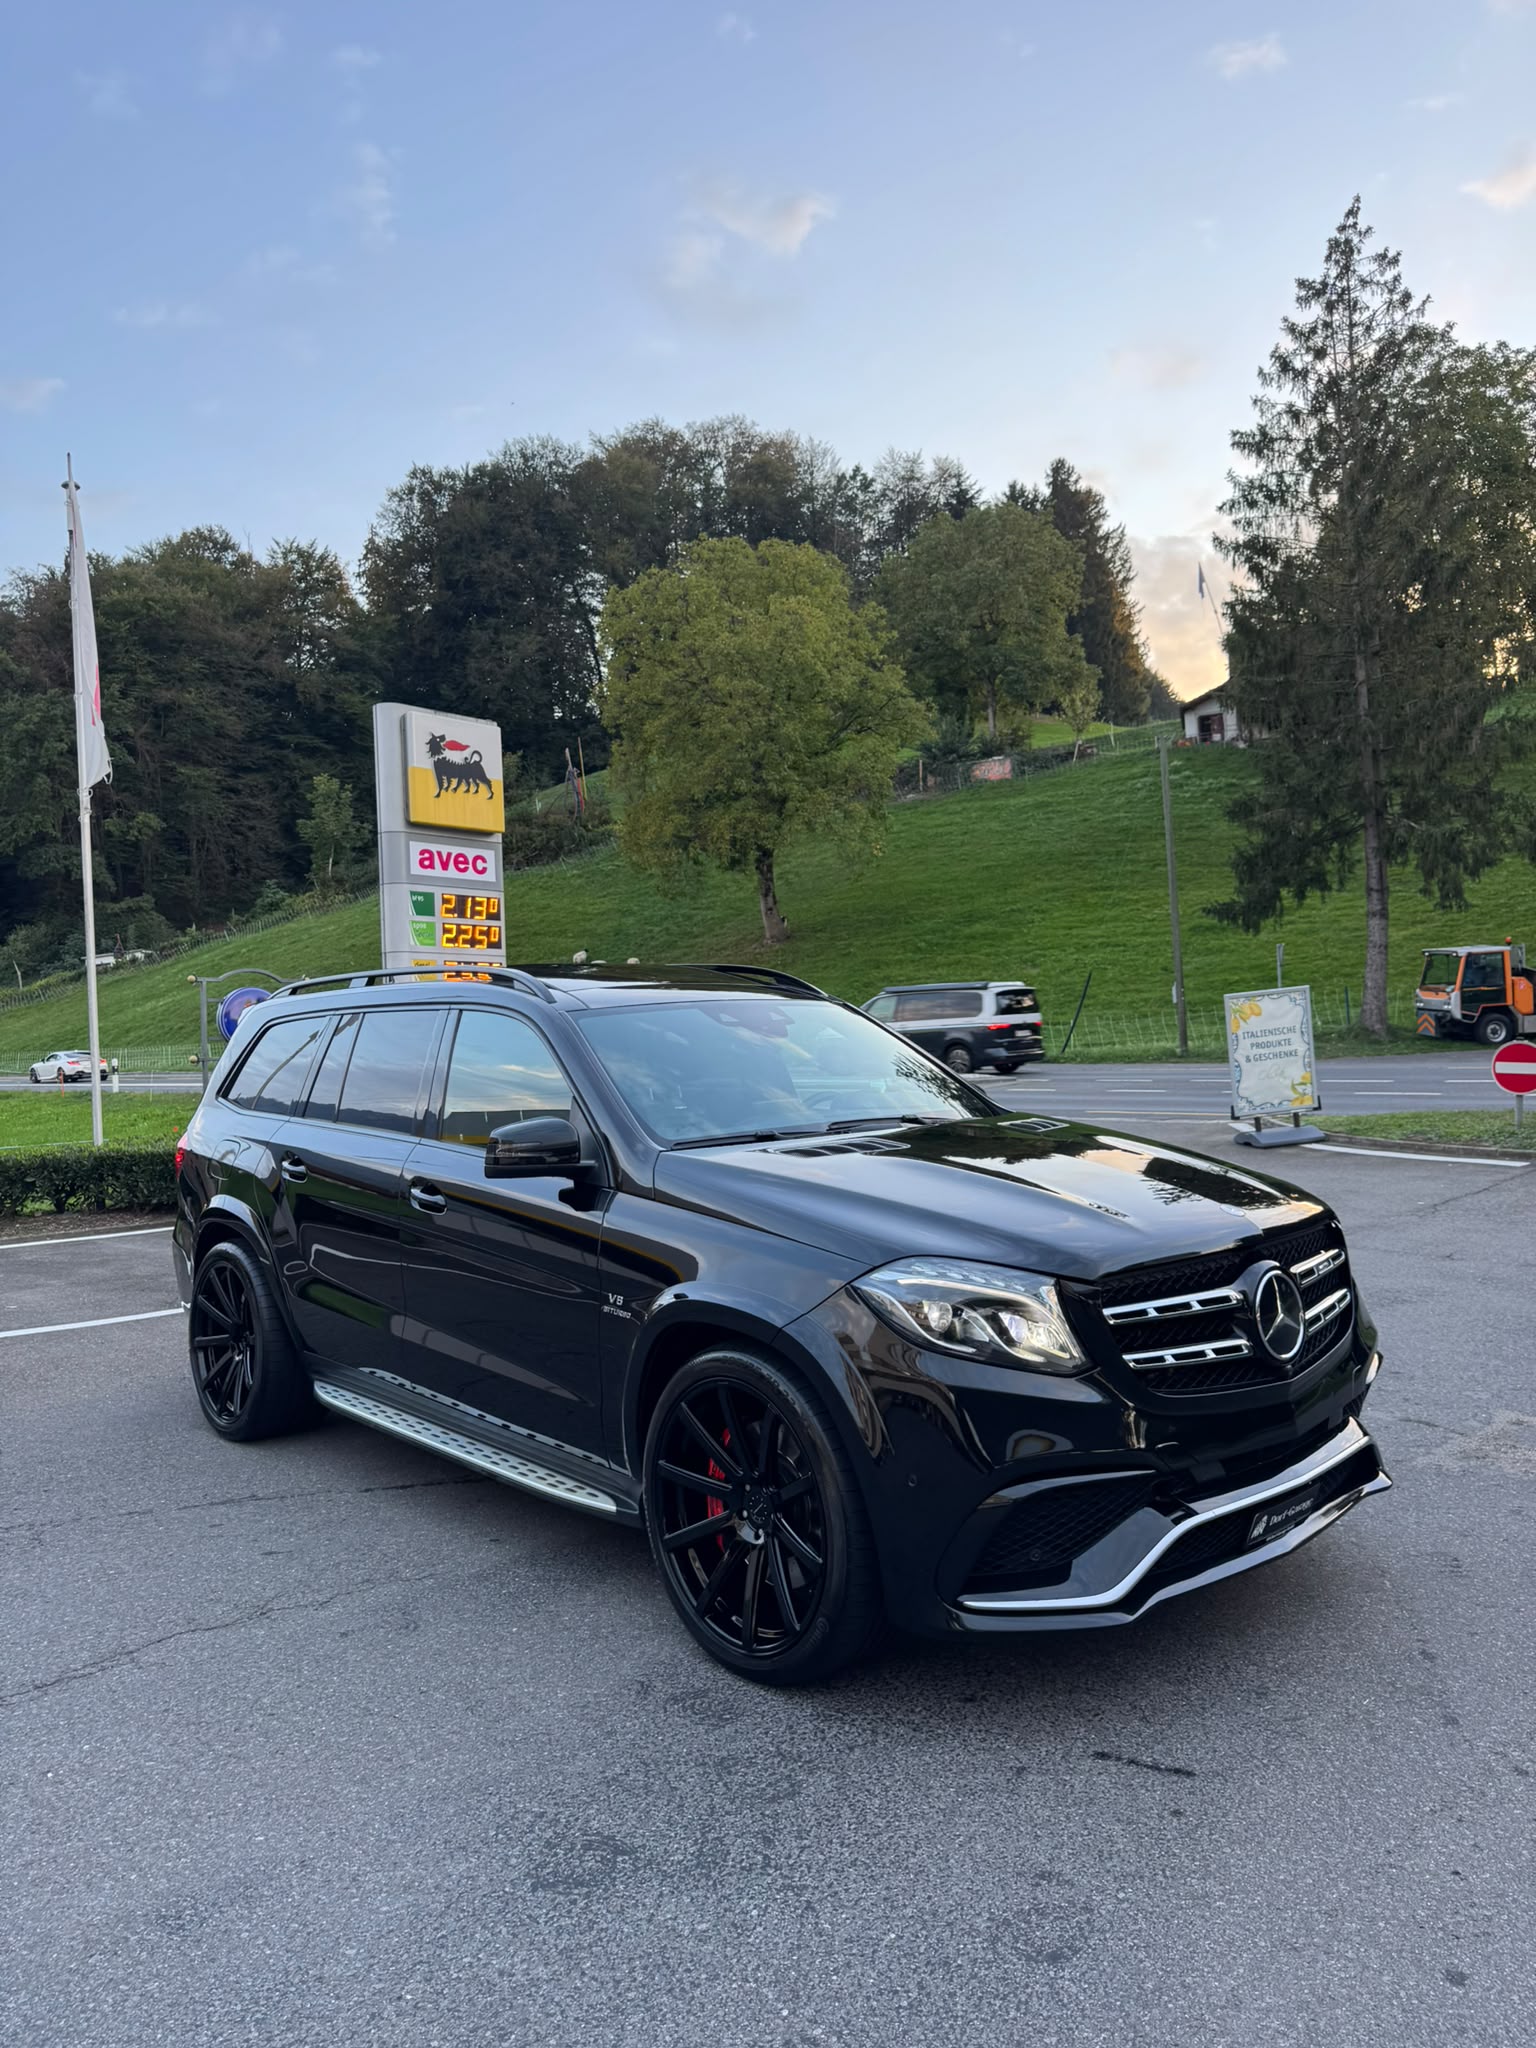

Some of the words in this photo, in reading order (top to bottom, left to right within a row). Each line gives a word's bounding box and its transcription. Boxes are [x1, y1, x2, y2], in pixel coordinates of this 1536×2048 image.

[418, 848, 488, 875] avec
[1242, 1025, 1297, 1040] ITALIENISCHE
[1250, 1038, 1292, 1050] PRODUKTE
[1245, 1055, 1251, 1063] &
[1253, 1049, 1299, 1062] GESCHENKE
[608, 1293, 624, 1305] V8
